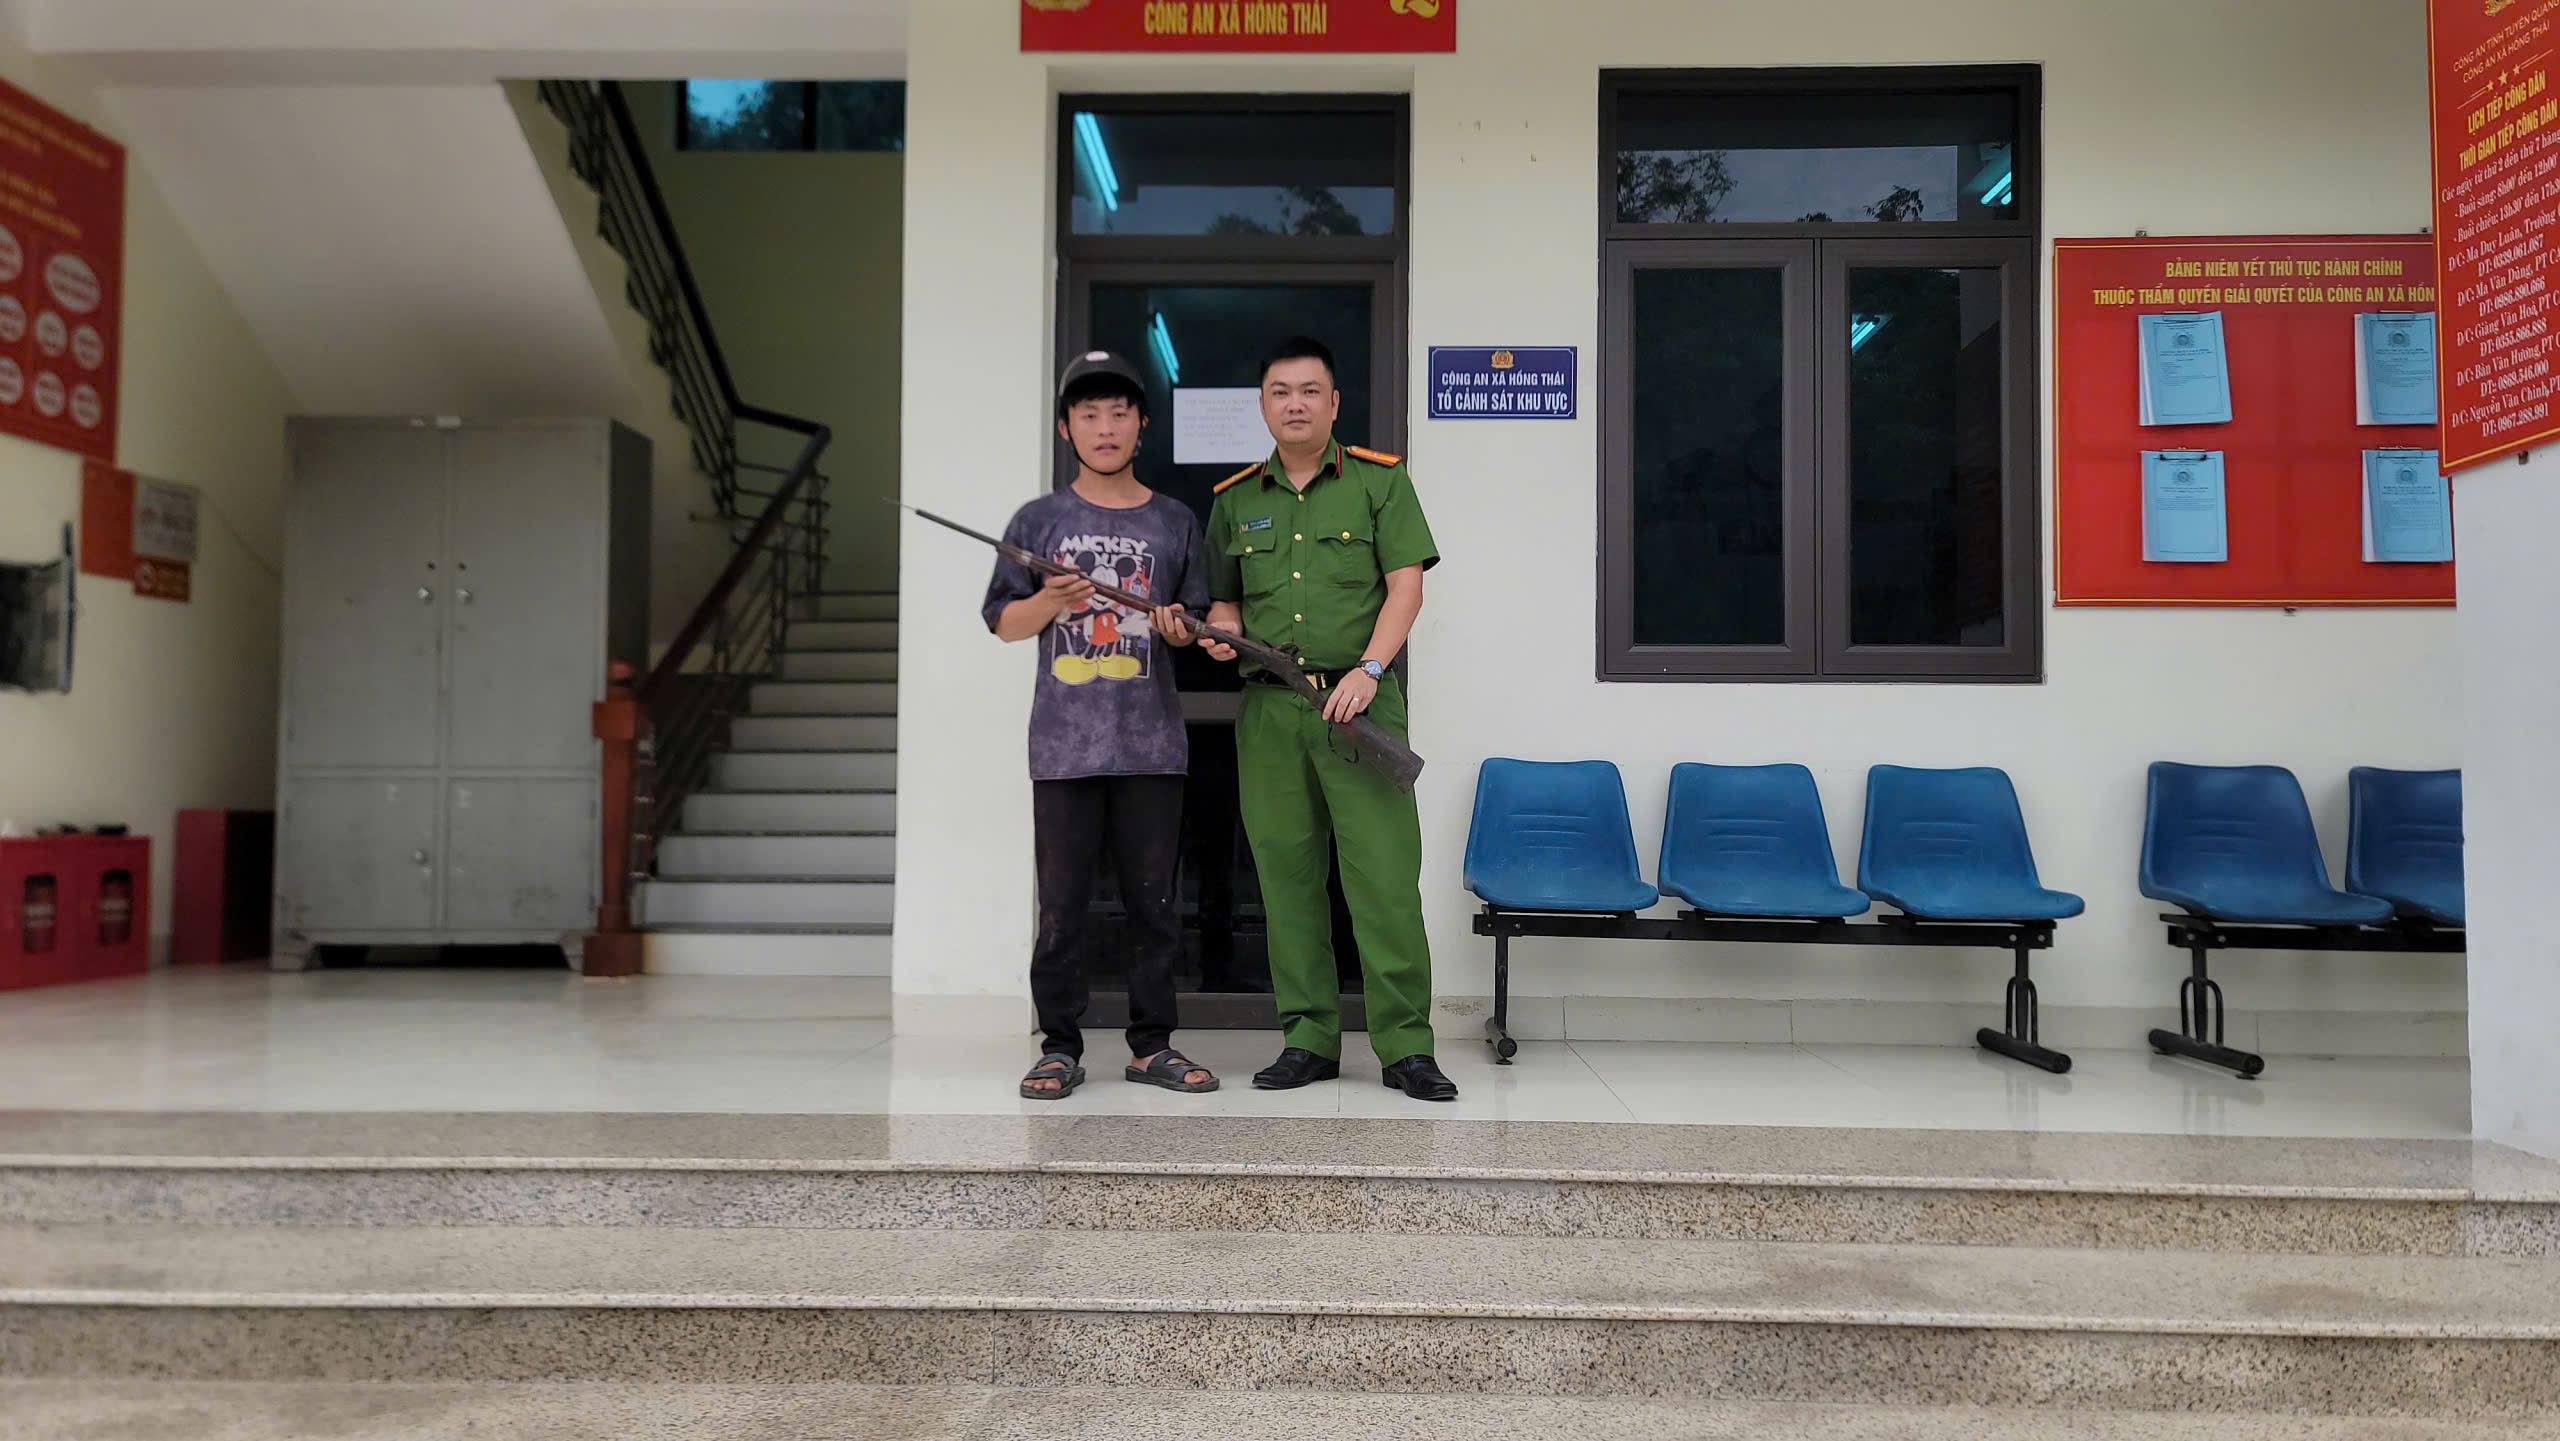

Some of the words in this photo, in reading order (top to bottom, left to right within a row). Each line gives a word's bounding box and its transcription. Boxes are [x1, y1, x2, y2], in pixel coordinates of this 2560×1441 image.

[1192, 2, 1215, 34] AN
[2475, 43, 2486, 58] AN
[2485, 54, 2496, 70] AN
[2468, 106, 2485, 136] LỊCH
[2486, 92, 2503, 122] TIẾP
[2504, 81, 2527, 111] CÔNG
[2528, 70, 2546, 98] DÂN
[2478, 133, 2497, 161] GIAN
[2497, 122, 2514, 149] TIẾP
[2516, 110, 2538, 139] CÔNG
[2540, 98, 2558, 126] DÂN
[2498, 158, 2504, 172] 2
[2535, 136, 2540, 152] 7
[2480, 240, 2498, 256] Duy
[2165, 256, 2202, 278] BẢNG
[2205, 258, 2240, 277] NIÊM
[2243, 256, 2266, 277] YẾT
[2269, 255, 2293, 277] THỦ
[2296, 260, 2321, 280] TỤC
[2324, 257, 2360, 276] HÀNH
[2363, 256, 2403, 276] CHÍNH
[2535, 252, 2548, 272] PT
[2092, 286, 2135, 308] THUỘC
[2138, 282, 2175, 305] THẨM
[2178, 283, 2221, 306] QUYỀN
[2224, 282, 2250, 304] GIẢI
[2254, 282, 2295, 304] QUYẾT
[2298, 282, 2324, 303] CỦA
[2327, 284, 2362, 303] CÔNG
[2366, 287, 2384, 303] AN
[2387, 284, 2405, 303] XÃ
[2408, 281, 2435, 303] HỒN
[2539, 293, 2551, 312] PT
[2542, 335, 2554, 354] PT
[1441, 370, 1471, 386] CÔNG
[1473, 373, 1489, 386] AN
[1491, 370, 1506, 386] XÃ
[1540, 370, 1565, 386] THÁI
[1437, 386, 1452, 410] TỔ
[1455, 387, 1488, 410] CẢNH
[1491, 389, 1514, 410] SÁT
[1517, 392, 1541, 410] KHU
[1544, 391, 1568, 414] VỰC
[1059, 534, 1149, 556] MICKEY
[1063, 552, 1144, 572] MUE
